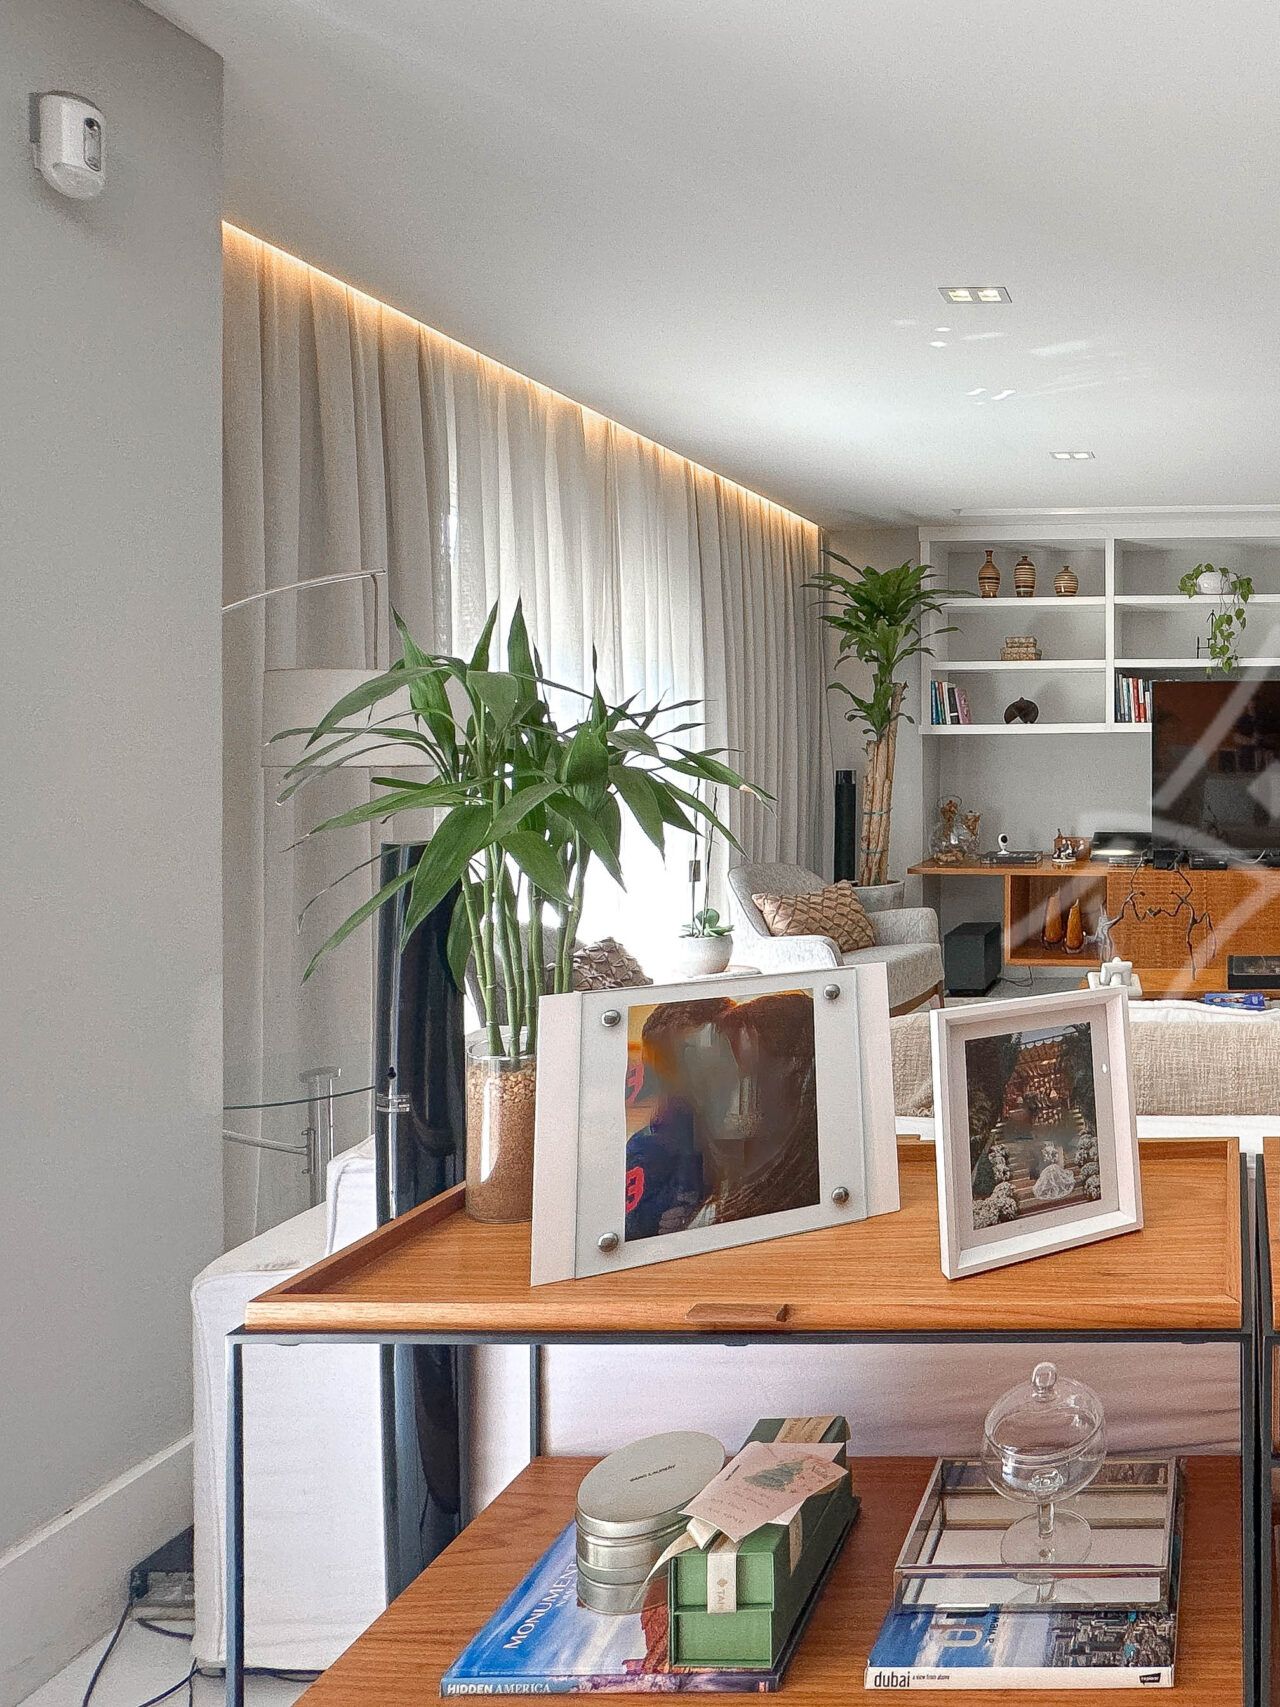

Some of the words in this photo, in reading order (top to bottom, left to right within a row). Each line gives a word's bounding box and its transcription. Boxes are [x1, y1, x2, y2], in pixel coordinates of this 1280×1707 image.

[503, 1561, 577, 1649] MONUMENT
[717, 1591, 726, 1610] TAN
[874, 1671, 910, 1687] dubai
[447, 1685, 493, 1694] HIDDEN
[495, 1684, 551, 1693] AMERICA
